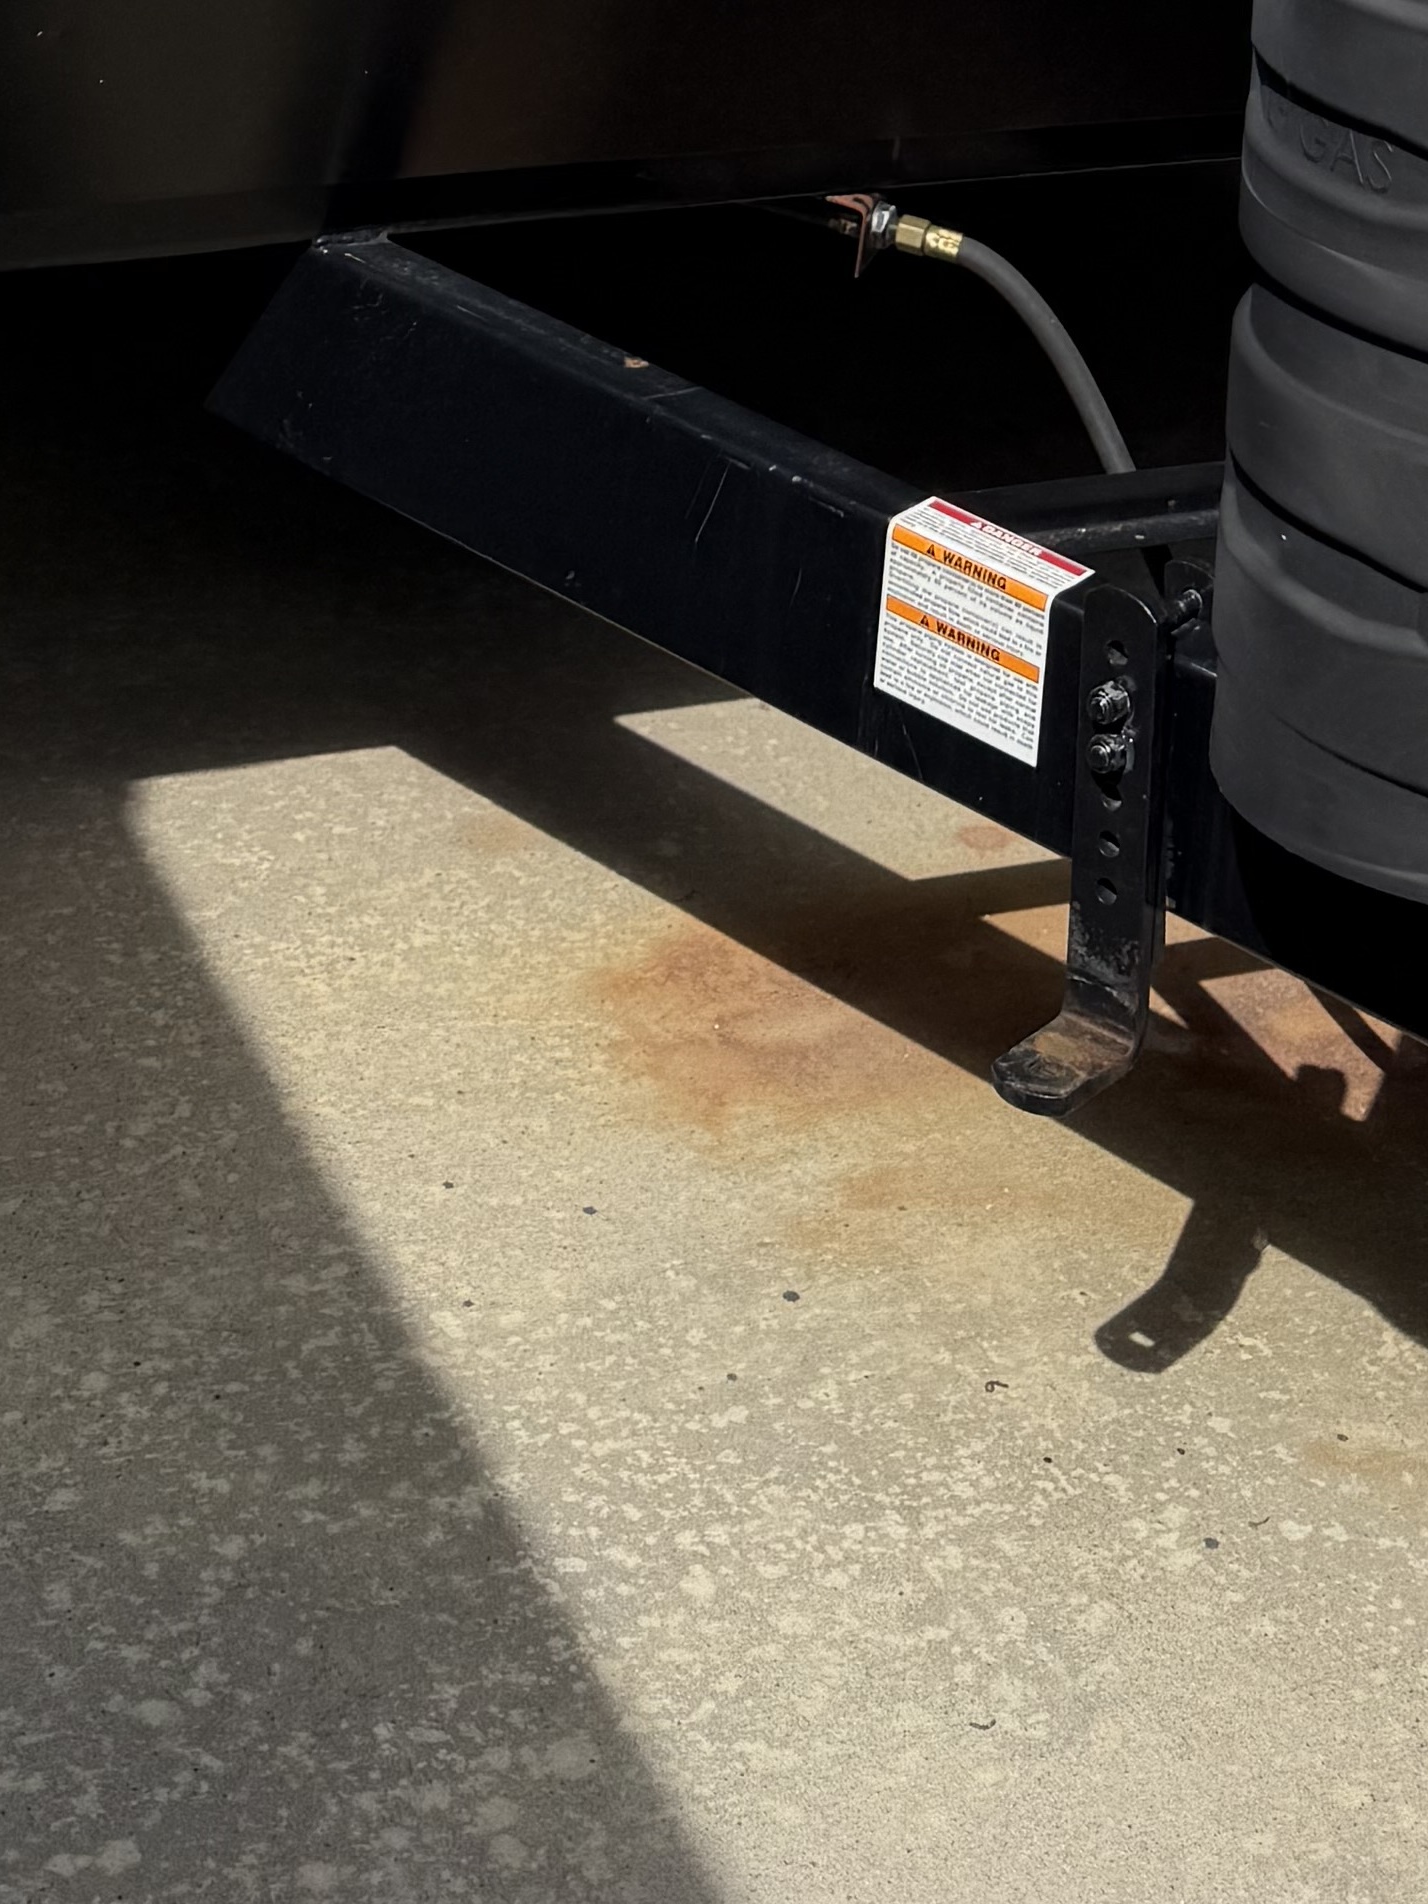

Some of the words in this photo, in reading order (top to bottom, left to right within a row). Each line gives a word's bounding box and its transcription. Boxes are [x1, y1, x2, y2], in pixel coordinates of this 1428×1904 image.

[983, 524, 1043, 556] DANGER
[943, 550, 1007, 590] WARNING
[936, 619, 1001, 662] WARNING
